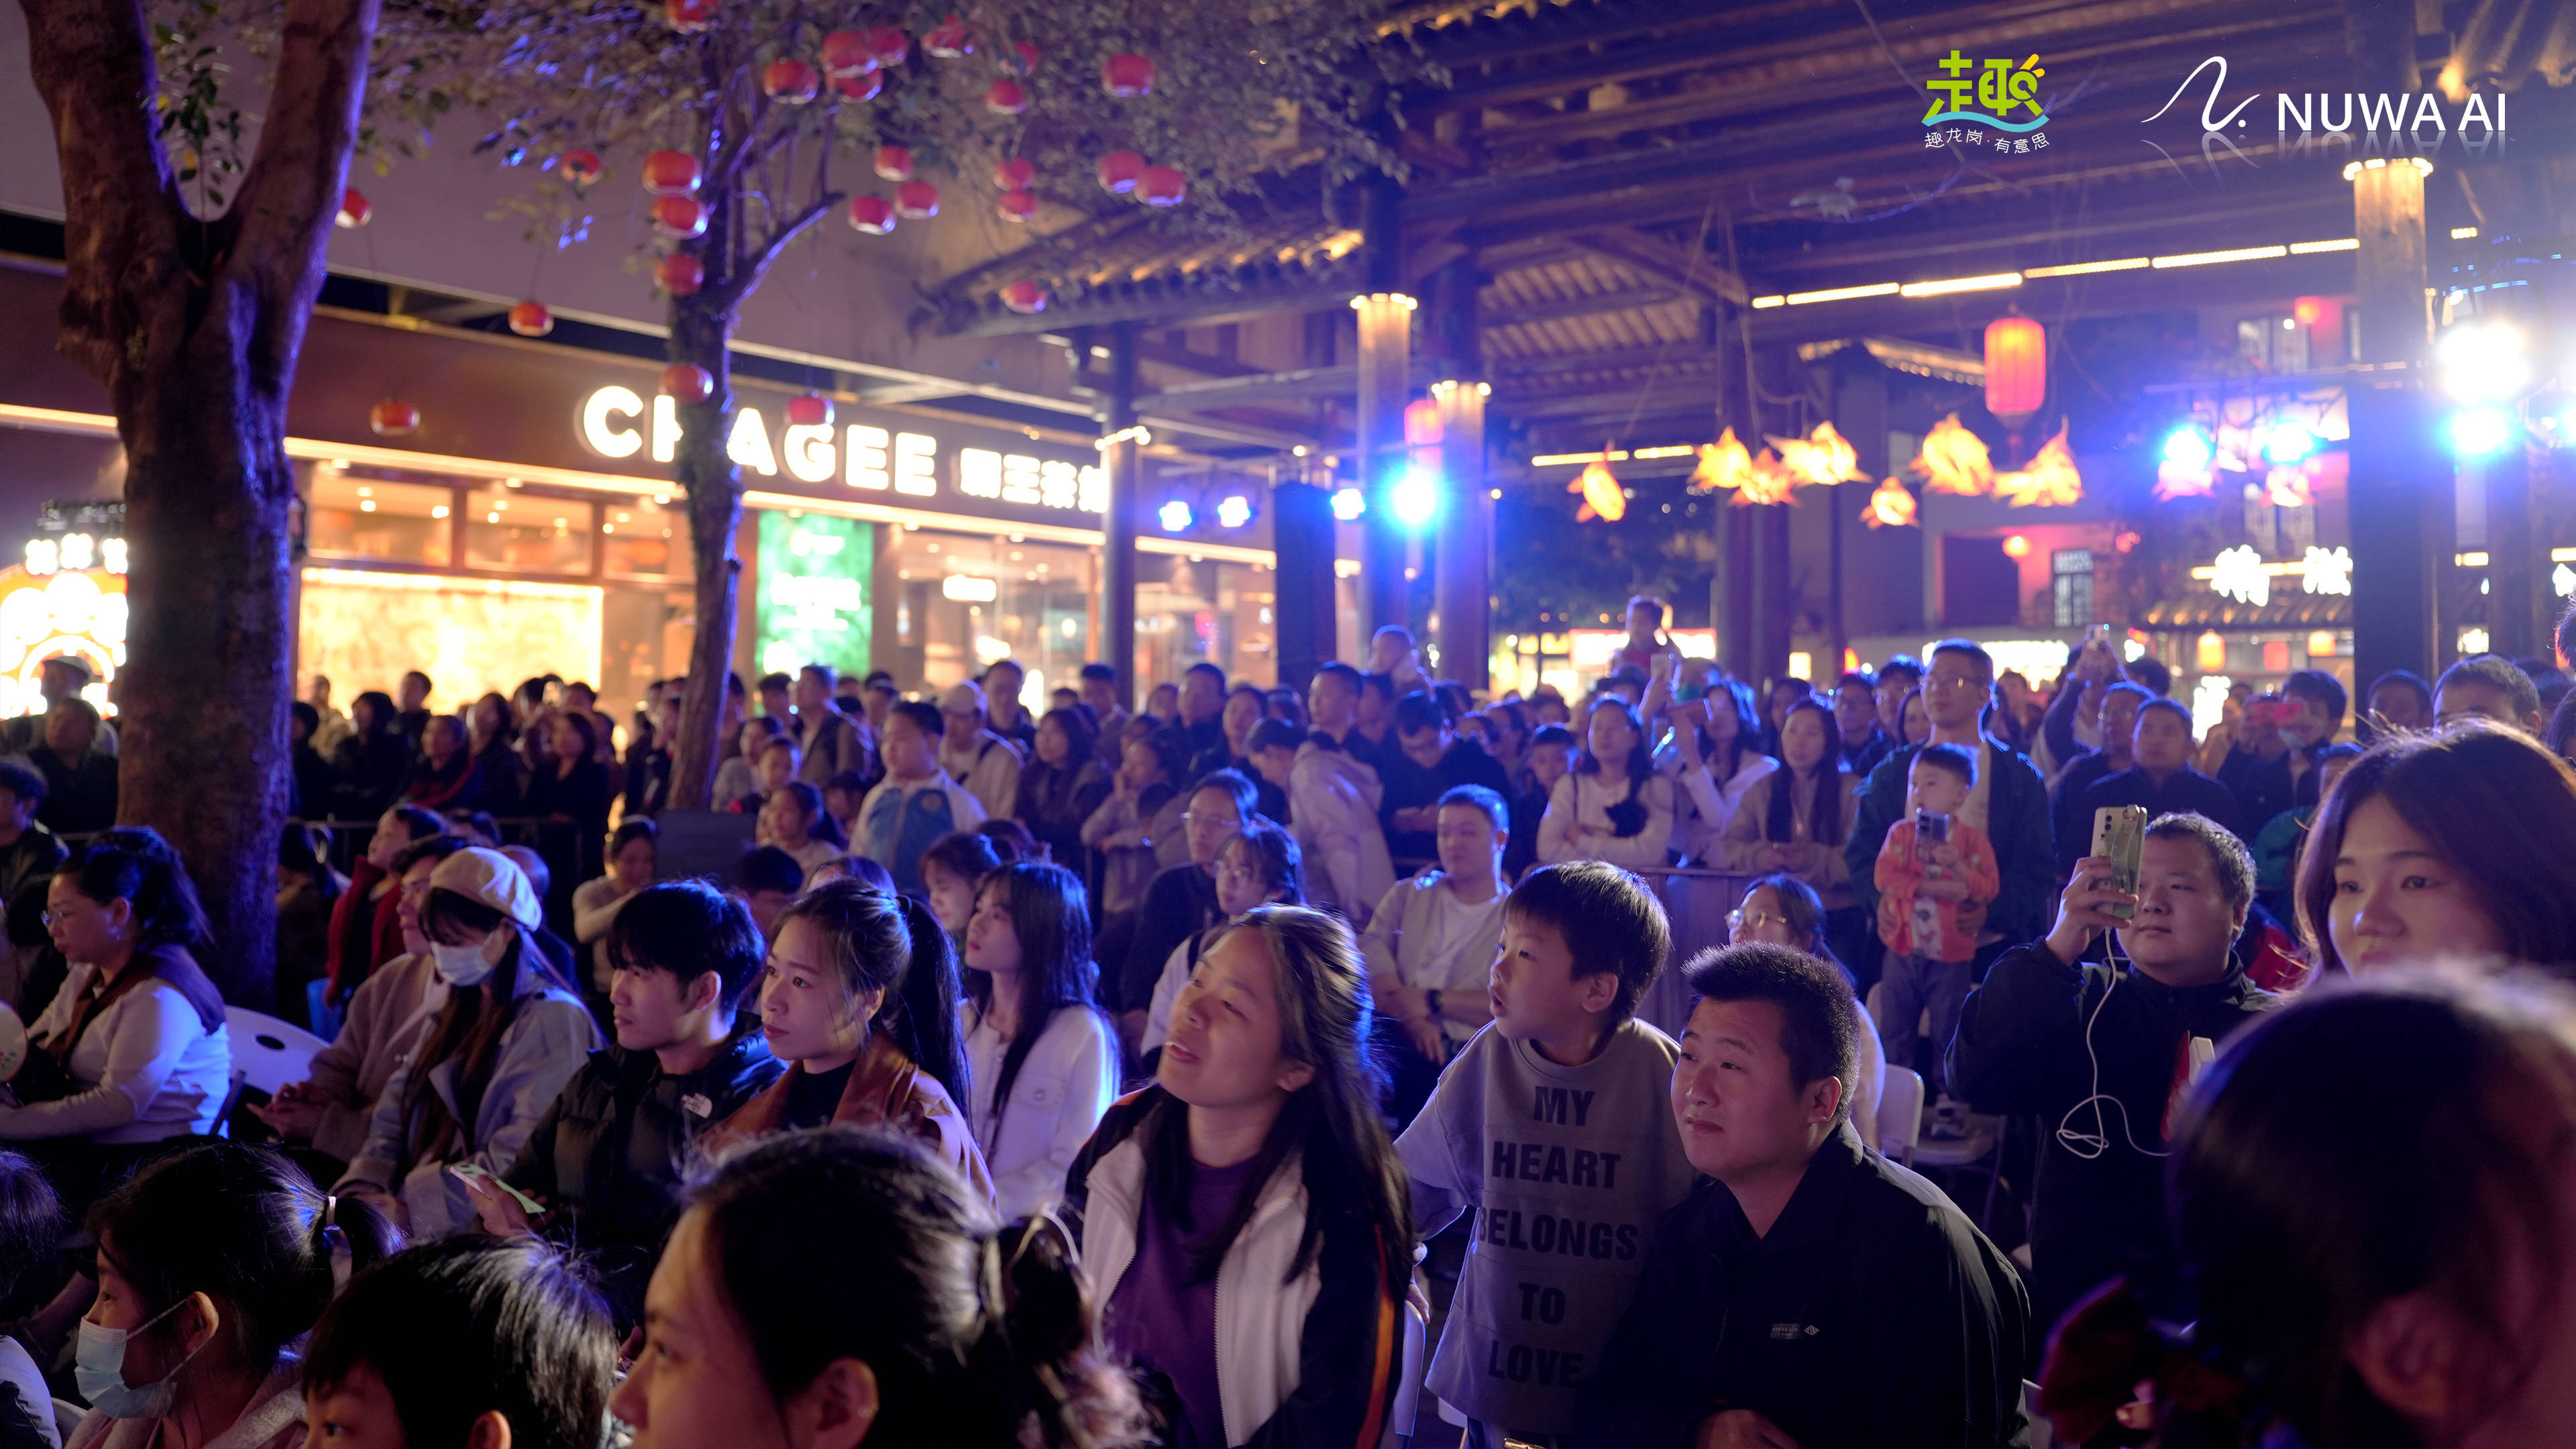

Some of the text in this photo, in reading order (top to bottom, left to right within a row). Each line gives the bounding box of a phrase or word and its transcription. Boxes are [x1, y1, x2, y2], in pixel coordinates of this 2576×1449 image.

[1534, 1085, 1595, 1126] MY
[1492, 1141, 1621, 1189] HEART
[1478, 1207, 1639, 1260] BELONGS
[1519, 1282, 1566, 1325] TO
[1488, 1340, 1583, 1389] LOVE
